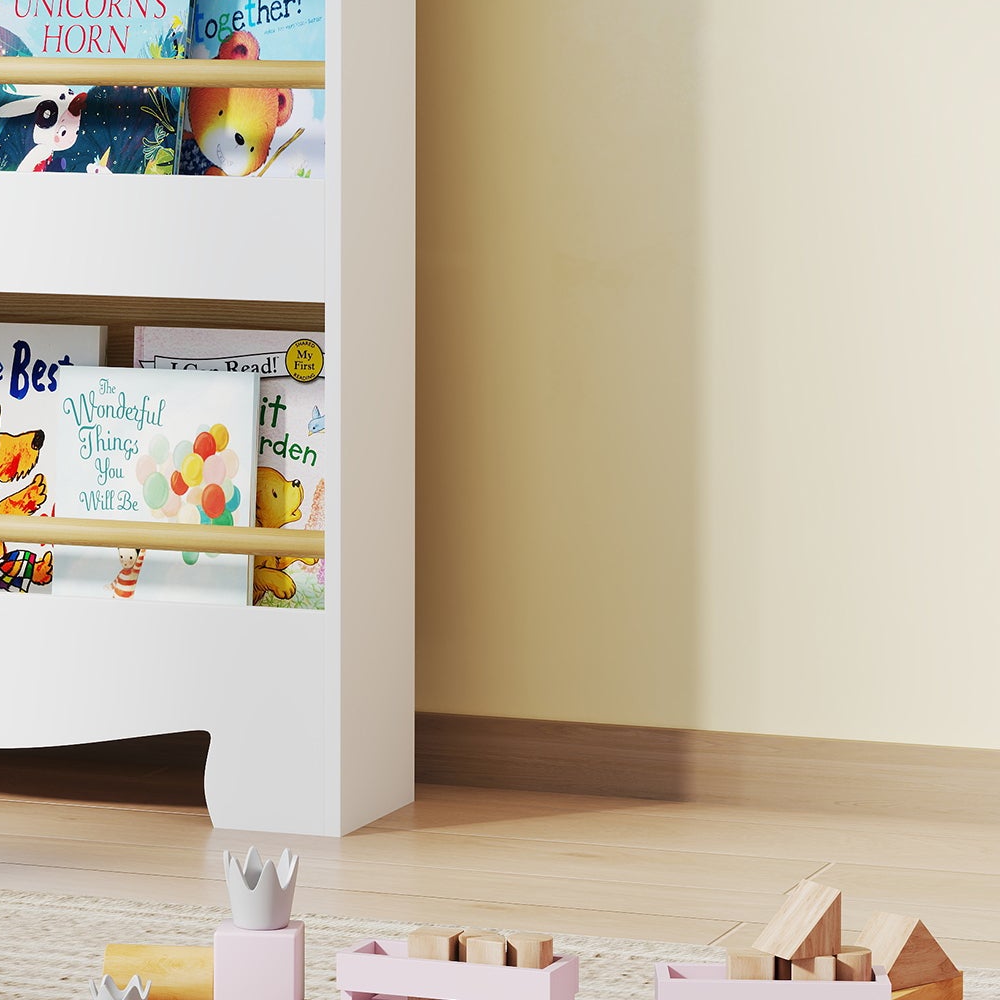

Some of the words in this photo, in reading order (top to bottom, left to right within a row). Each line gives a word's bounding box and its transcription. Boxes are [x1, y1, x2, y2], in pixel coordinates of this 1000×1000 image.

[42, 24, 130, 54] HORN
[294, 361, 315, 370] First
[297, 350, 313, 361] My
[99, 378, 116, 395] The
[63, 390, 166, 431] Wonderful
[260, 395, 287, 428] it
[78, 424, 139, 460] Things
[259, 433, 318, 467] rden
[95, 457, 124, 485] You
[79, 490, 115, 511] Will
[117, 490, 139, 511] Be
